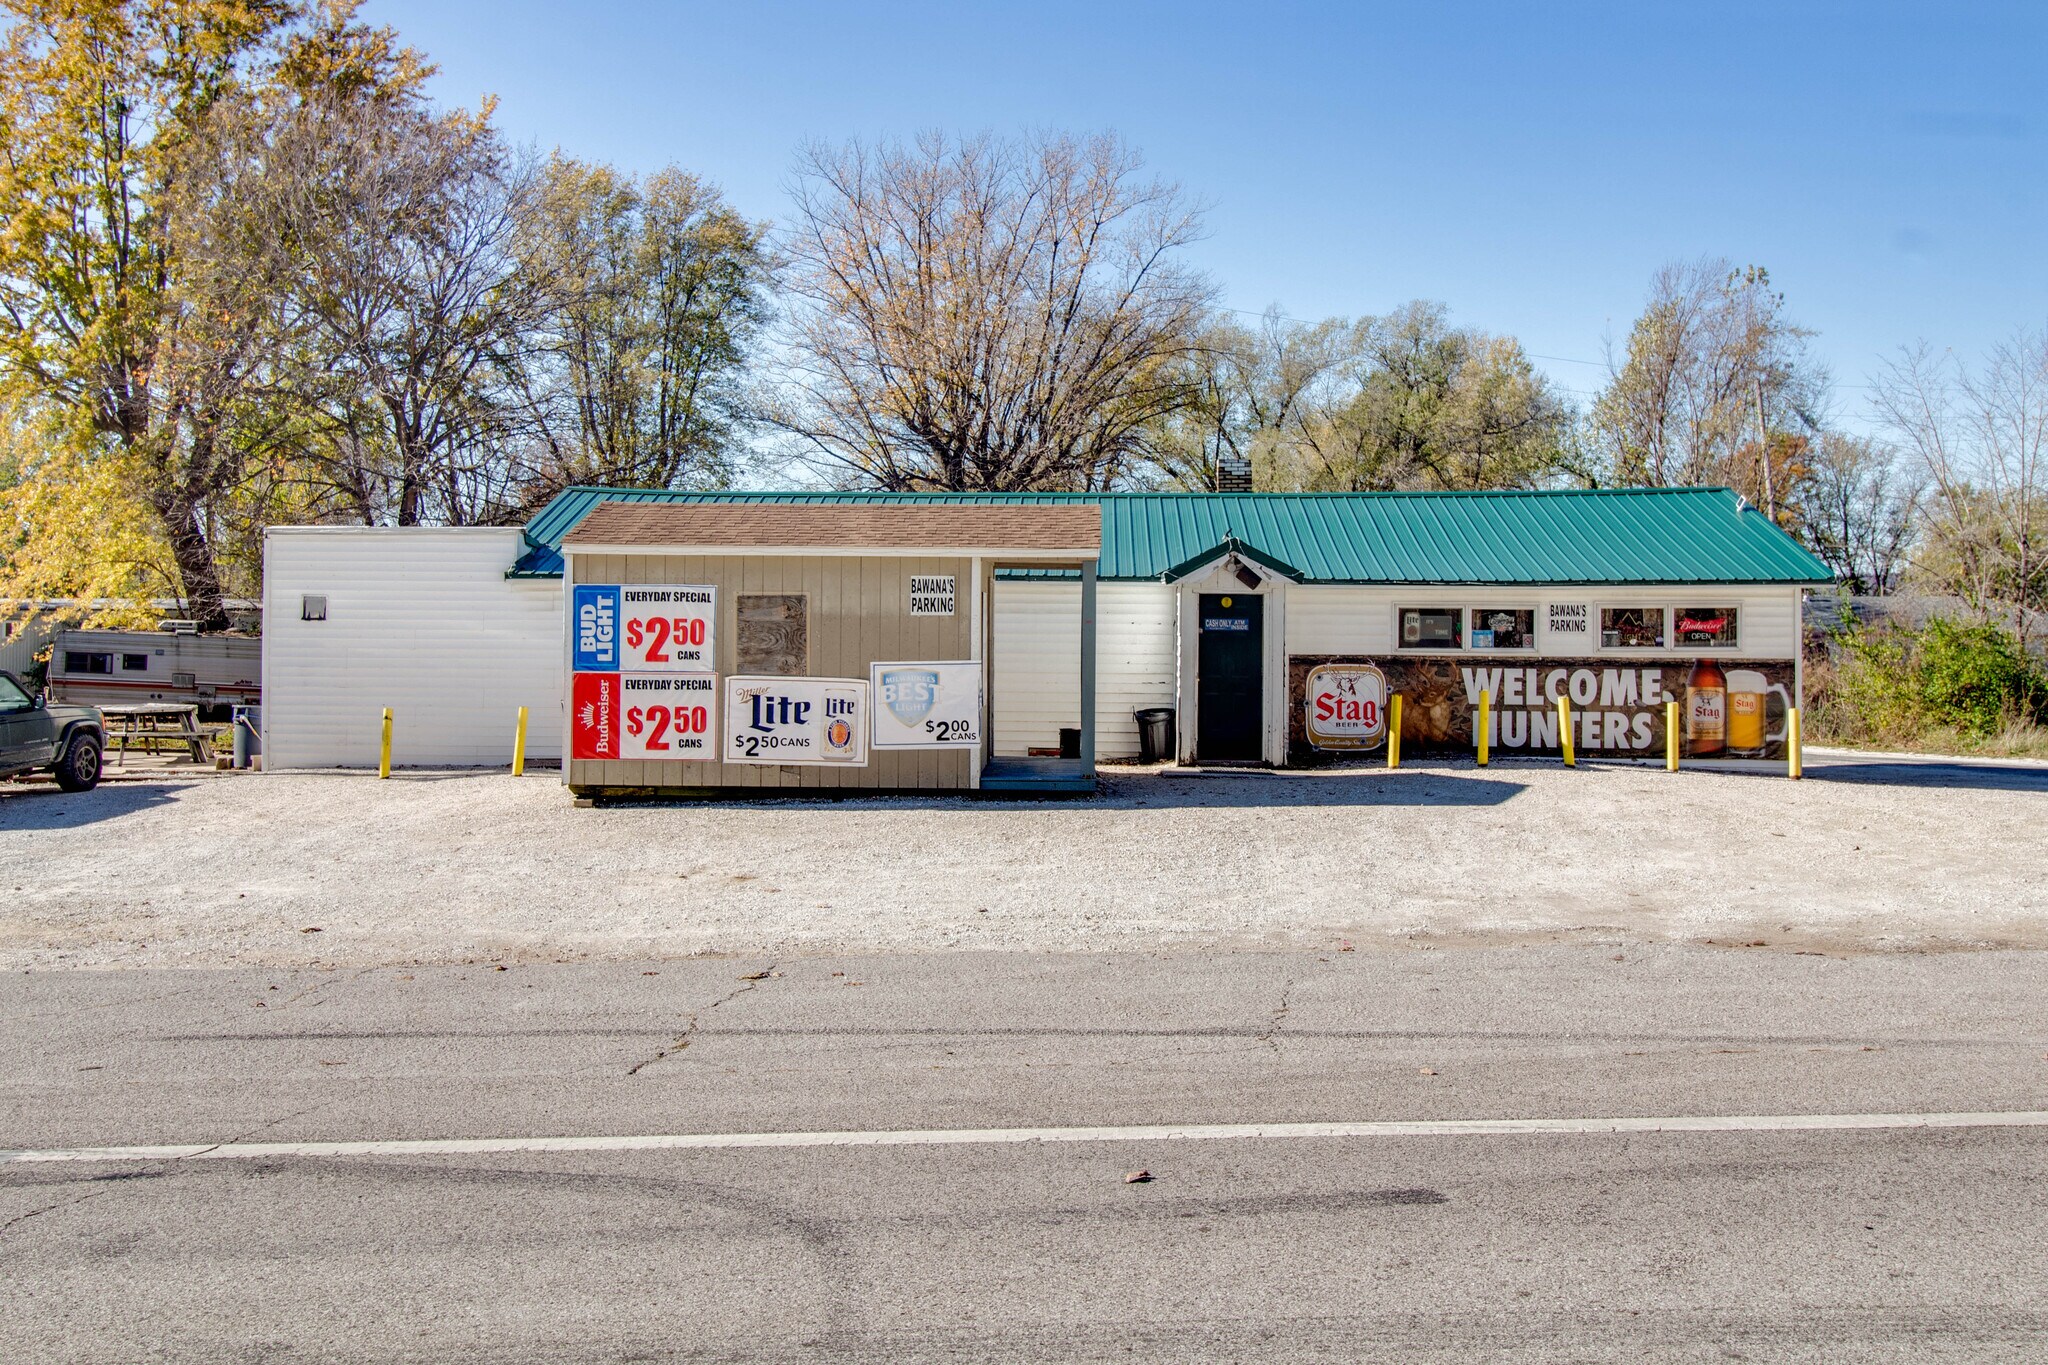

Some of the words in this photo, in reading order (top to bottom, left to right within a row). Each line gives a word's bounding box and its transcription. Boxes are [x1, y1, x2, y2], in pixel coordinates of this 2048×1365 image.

[911, 578, 954, 594] BAWANA'S
[625, 591, 671, 602] EVERYDAY
[673, 591, 712, 603] SPECIAL
[911, 597, 954, 613] PARKING
[1550, 604, 1587, 617] BAWANA'S
[580, 603, 597, 652] BUD
[597, 595, 614, 662] LIGHT
[1205, 619, 1219, 628] CASH
[1219, 619, 1232, 628] ONLY
[1550, 619, 1586, 632] PARKING
[1678, 620, 1721, 630] Budweiser
[1691, 632, 1711, 640] OPEN
[677, 650, 701, 661] CANS
[625, 679, 672, 690] EVERYDAY
[674, 680, 712, 690] SPECIAL
[1461, 667, 1662, 707] WELCOME
[735, 687, 771, 704] Miller
[879, 682, 945, 704] BEST
[825, 698, 855, 718] Lite
[895, 703, 927, 712] LIGHT
[1315, 692, 1378, 729] Stag
[1735, 699, 1754, 709] Stag
[596, 679, 610, 753] Budweiser
[748, 694, 811, 733] Lite
[1695, 705, 1720, 719] Stag
[780, 738, 810, 747] CANS
[950, 732, 977, 741] CANS
[678, 738, 702, 749] CANS
